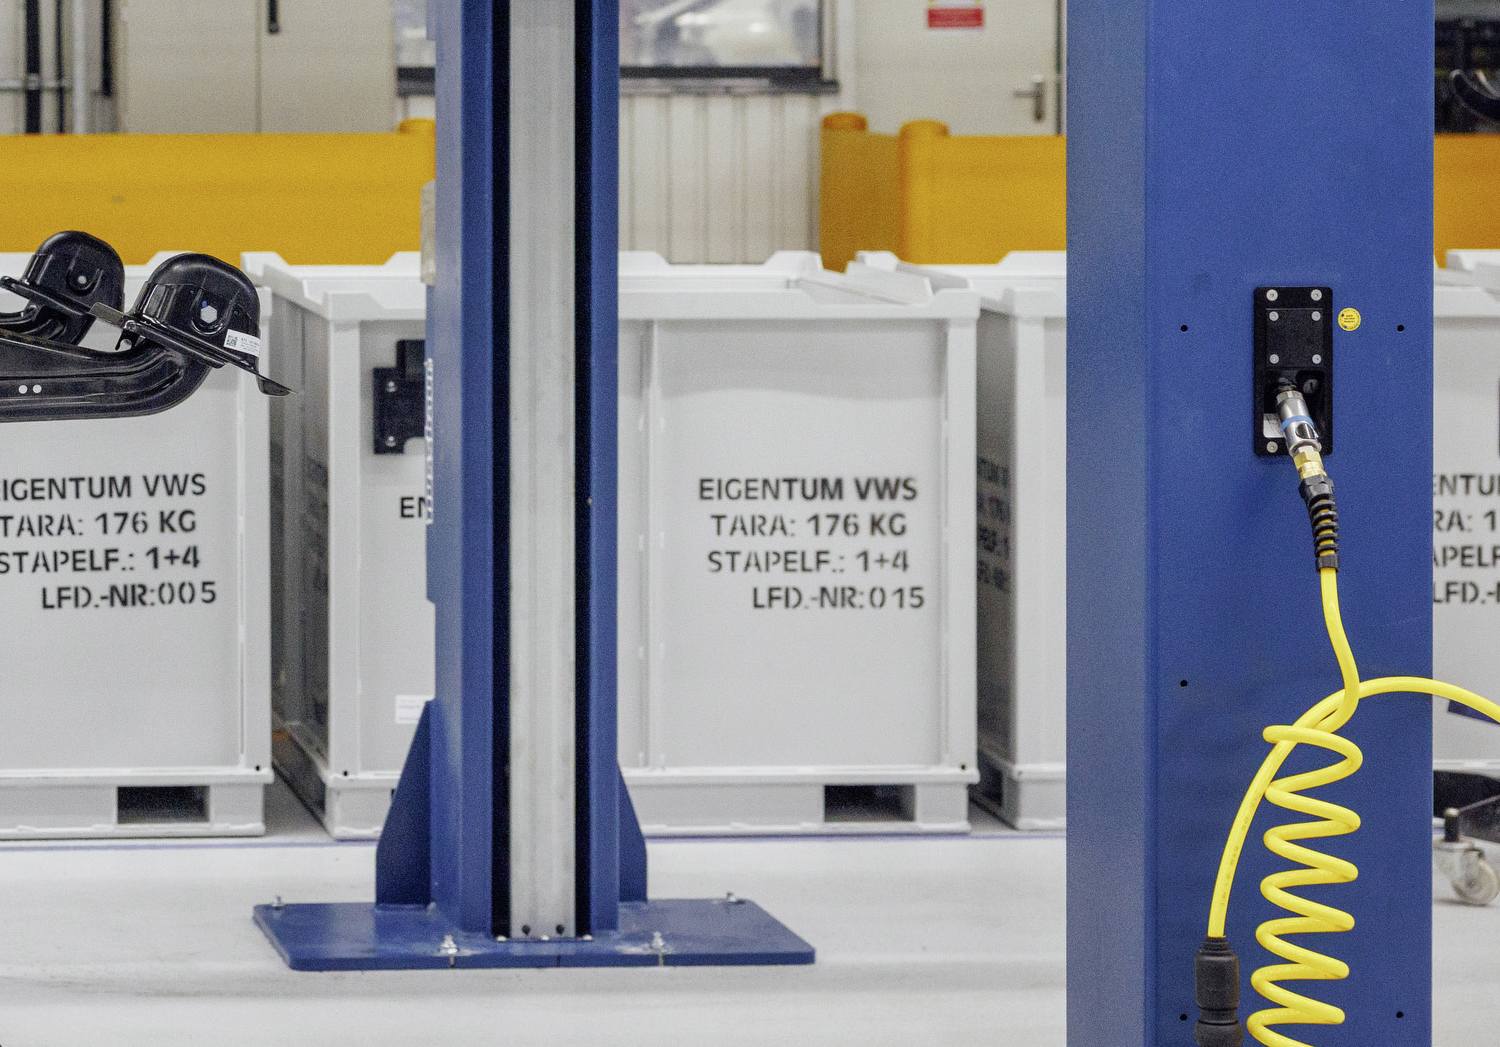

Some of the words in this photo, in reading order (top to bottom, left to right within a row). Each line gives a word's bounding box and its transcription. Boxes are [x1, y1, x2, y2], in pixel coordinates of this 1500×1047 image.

[143, 473, 207, 497] VWS
[699, 477, 844, 501] EIGENTUM
[854, 478, 918, 501] VWS
[95, 512, 149, 534] 176
[159, 509, 197, 533] KG
[711, 515, 796, 536] TARA:
[807, 514, 860, 536] 176
[870, 513, 907, 536] KG
[1433, 510, 1472, 531] RA:
[146, 545, 201, 569] 1+4
[708, 550, 844, 572] STAPELF.:
[856, 550, 910, 572] 1+4
